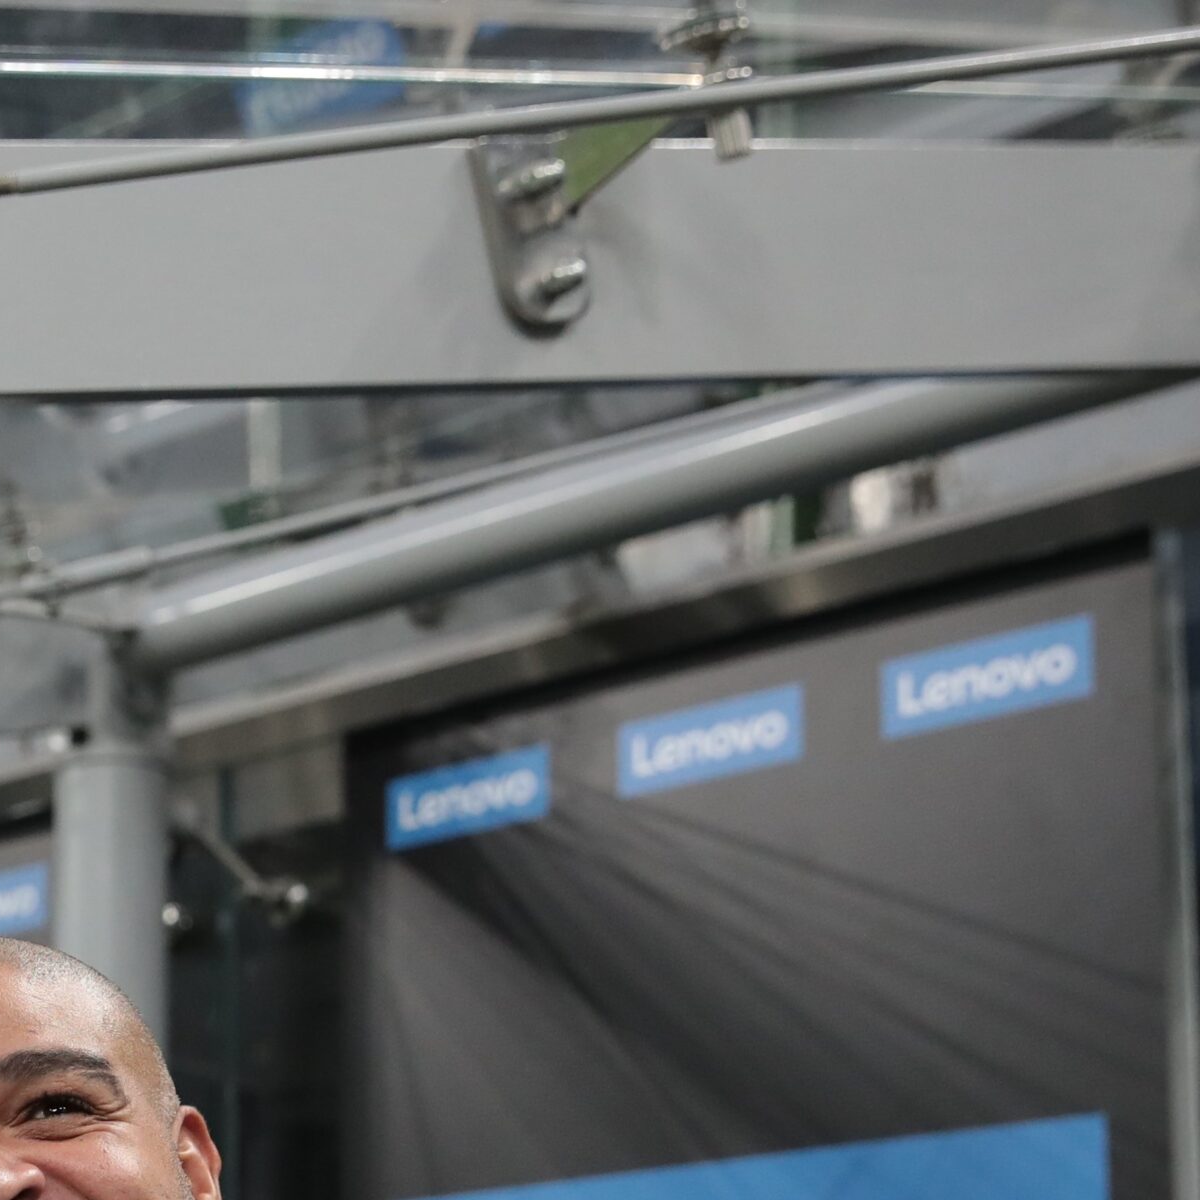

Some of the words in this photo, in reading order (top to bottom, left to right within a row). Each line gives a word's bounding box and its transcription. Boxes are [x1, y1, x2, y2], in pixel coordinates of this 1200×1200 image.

[898, 642, 1078, 718] Lenovo
[631, 708, 788, 780] Lenovo
[399, 766, 539, 832] Lenovo
